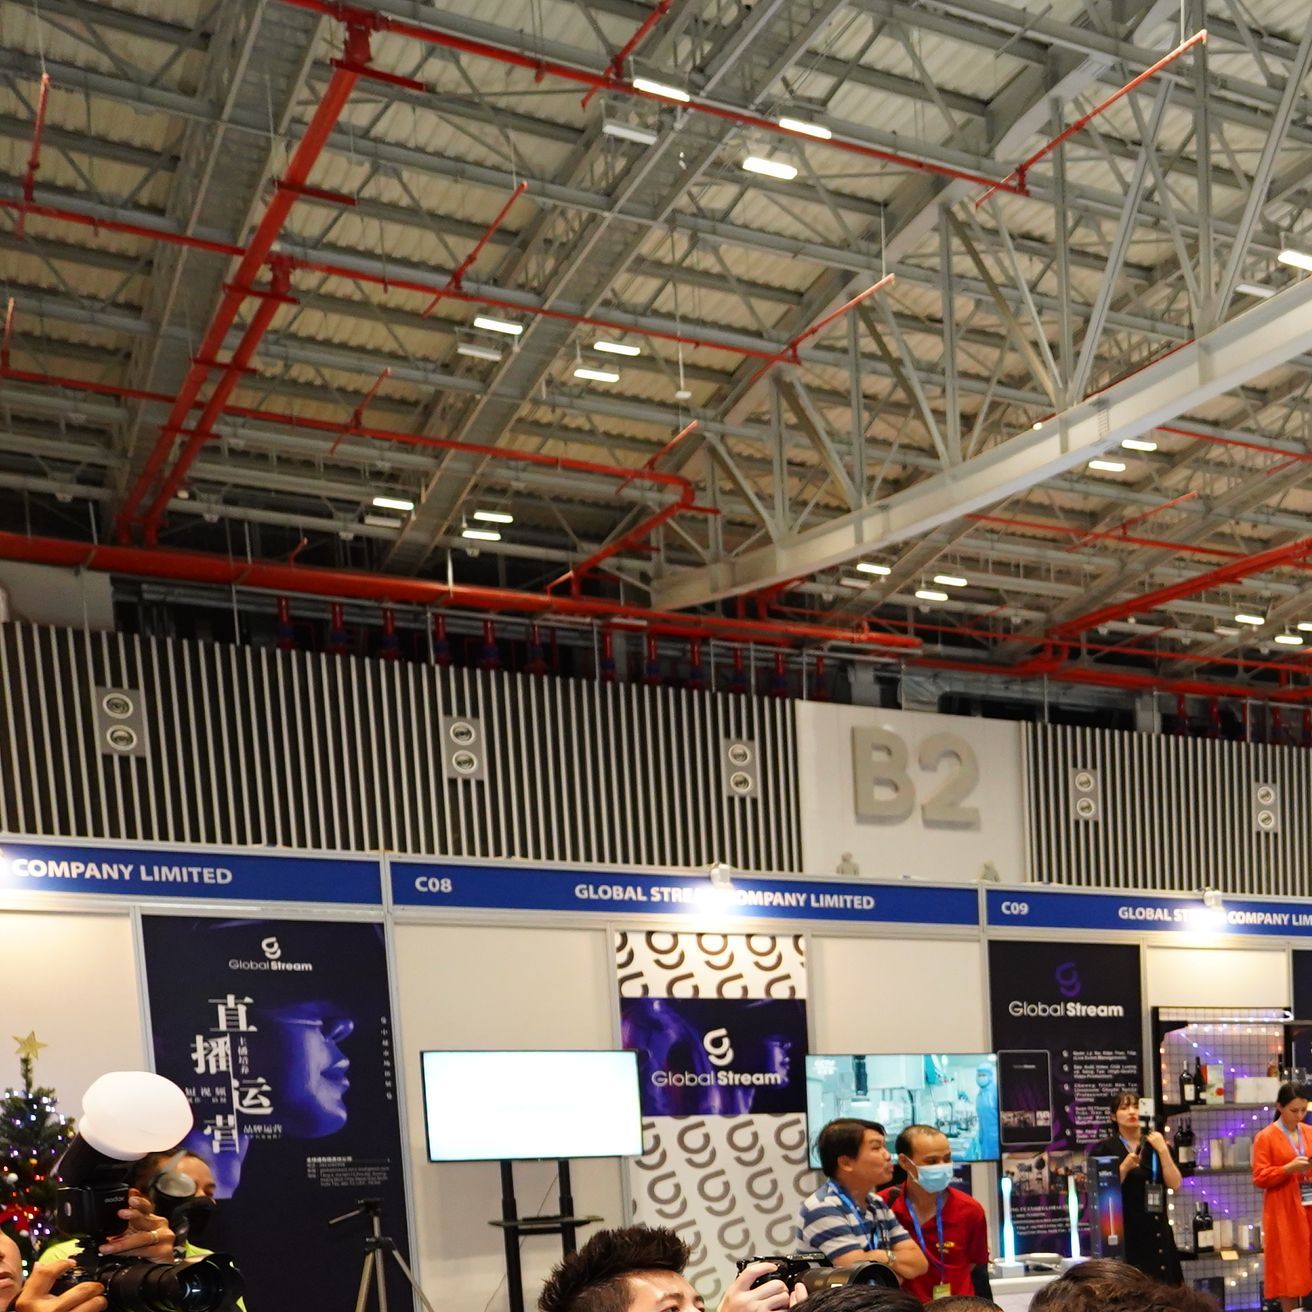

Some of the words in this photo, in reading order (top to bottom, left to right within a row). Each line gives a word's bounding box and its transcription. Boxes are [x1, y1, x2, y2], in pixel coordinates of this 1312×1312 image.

[850, 725, 981, 830] B2
[12, 858, 133, 881] COMPANY
[140, 865, 233, 885] LIMITED
[414, 876, 453, 894] C08
[574, 883, 647, 902] GLOBAL
[810, 893, 876, 911] LIMITED
[1001, 901, 1029, 916] C09
[1118, 906, 1172, 922] GLOBAL
[1227, 911, 1289, 927] COMPANY
[229, 958, 270, 970] Global
[270, 960, 313, 972] Stream
[1008, 1000, 1065, 1017] Global
[1066, 1002, 1124, 1017] Stream
[651, 1070, 715, 1087] Global
[717, 1070, 781, 1086] Stream
